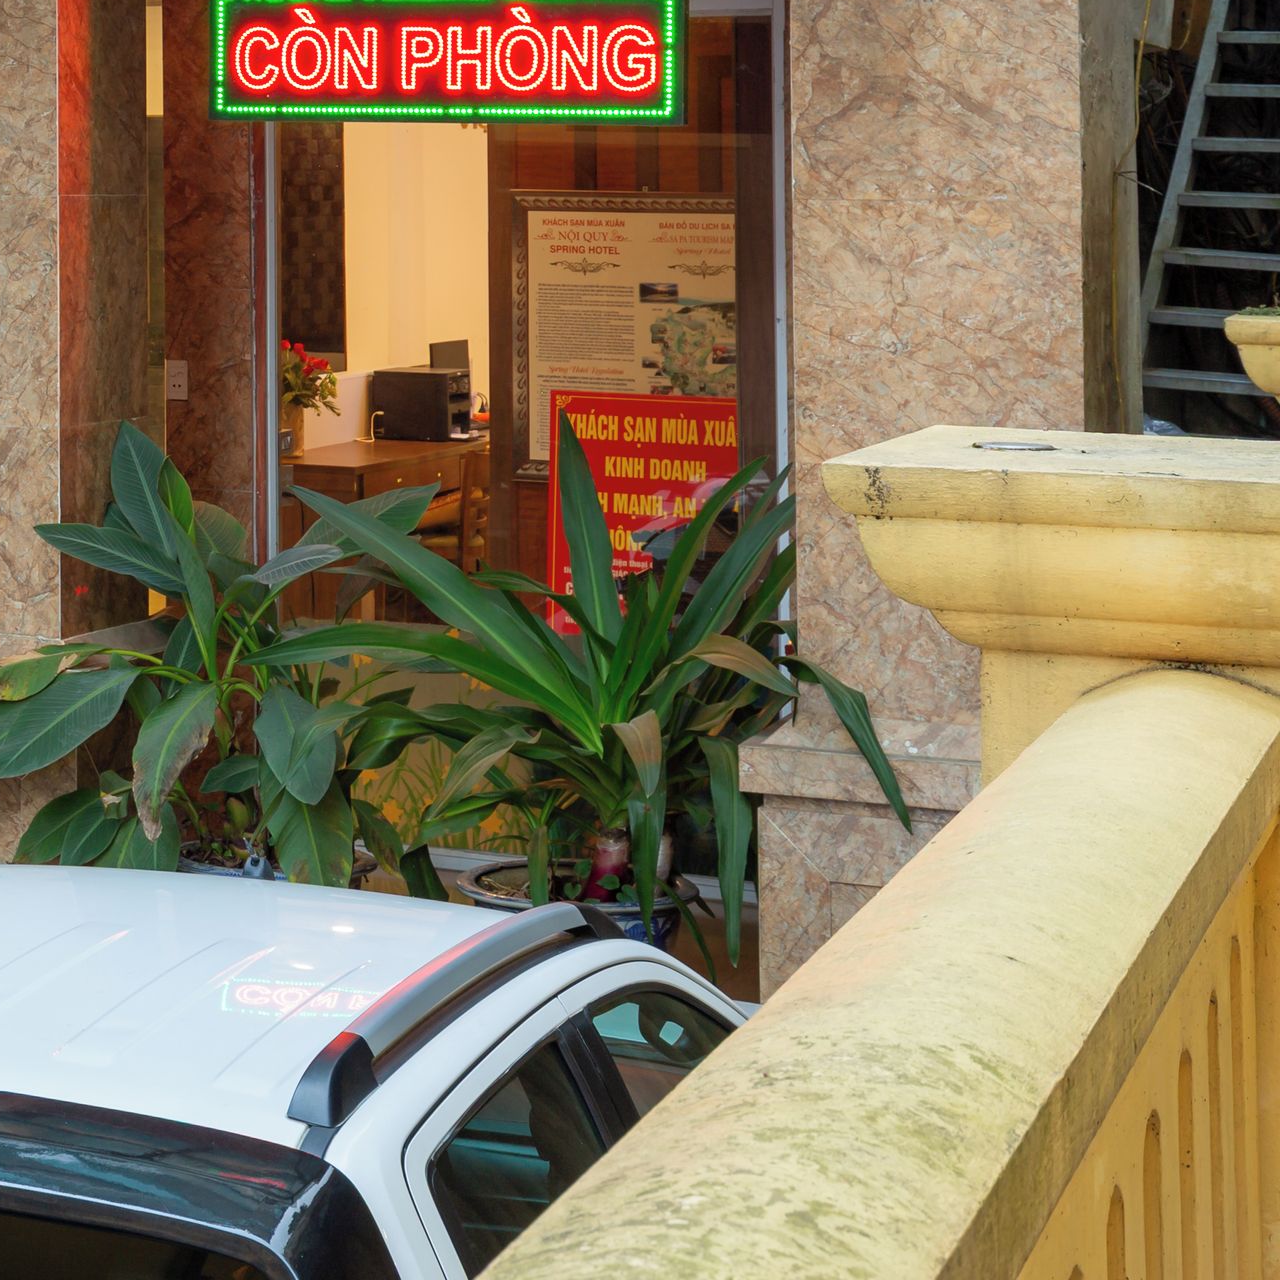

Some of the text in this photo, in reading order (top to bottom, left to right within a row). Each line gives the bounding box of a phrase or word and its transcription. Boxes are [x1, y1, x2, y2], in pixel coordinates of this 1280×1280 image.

[234, 6, 658, 92] CÒN PHÒNG
[550, 245, 620, 255] SPRING HOTEL
[623, 415, 658, 449] SẠN
[661, 413, 699, 446] MÙA
[703, 415, 737, 448] XUÂ
[605, 456, 707, 482] KINH DOANH
[613, 492, 668, 520] MẠNH,
